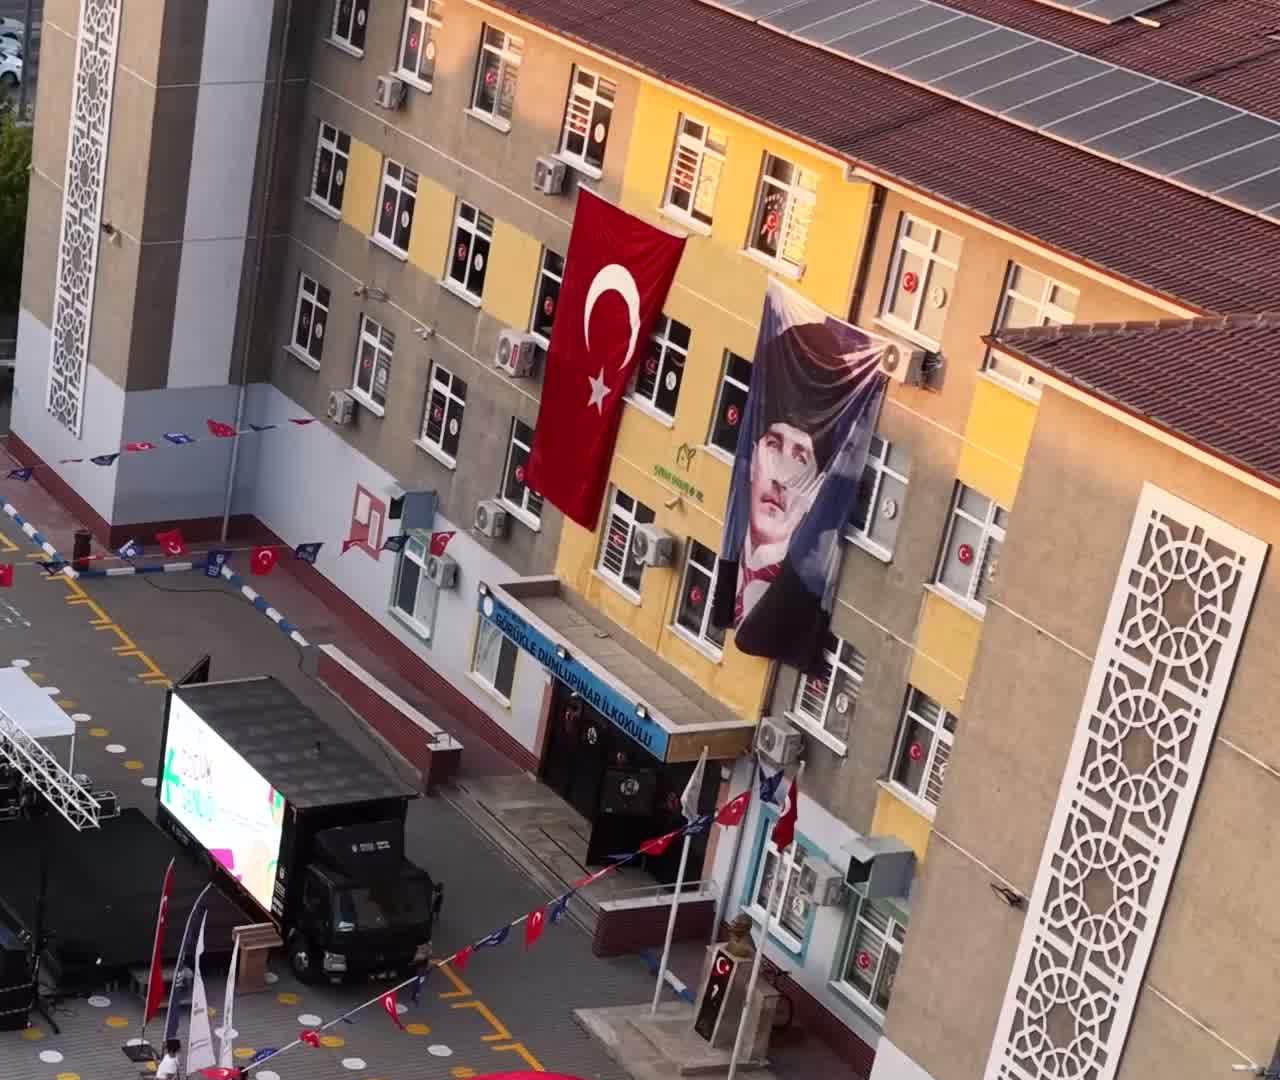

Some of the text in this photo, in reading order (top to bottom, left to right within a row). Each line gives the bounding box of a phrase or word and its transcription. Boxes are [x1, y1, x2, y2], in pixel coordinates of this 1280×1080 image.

[495, 613, 538, 656] GÖRÜKLE
[539, 645, 602, 706] DUMLUPINAR
[602, 694, 653, 746] İLKOKULU
